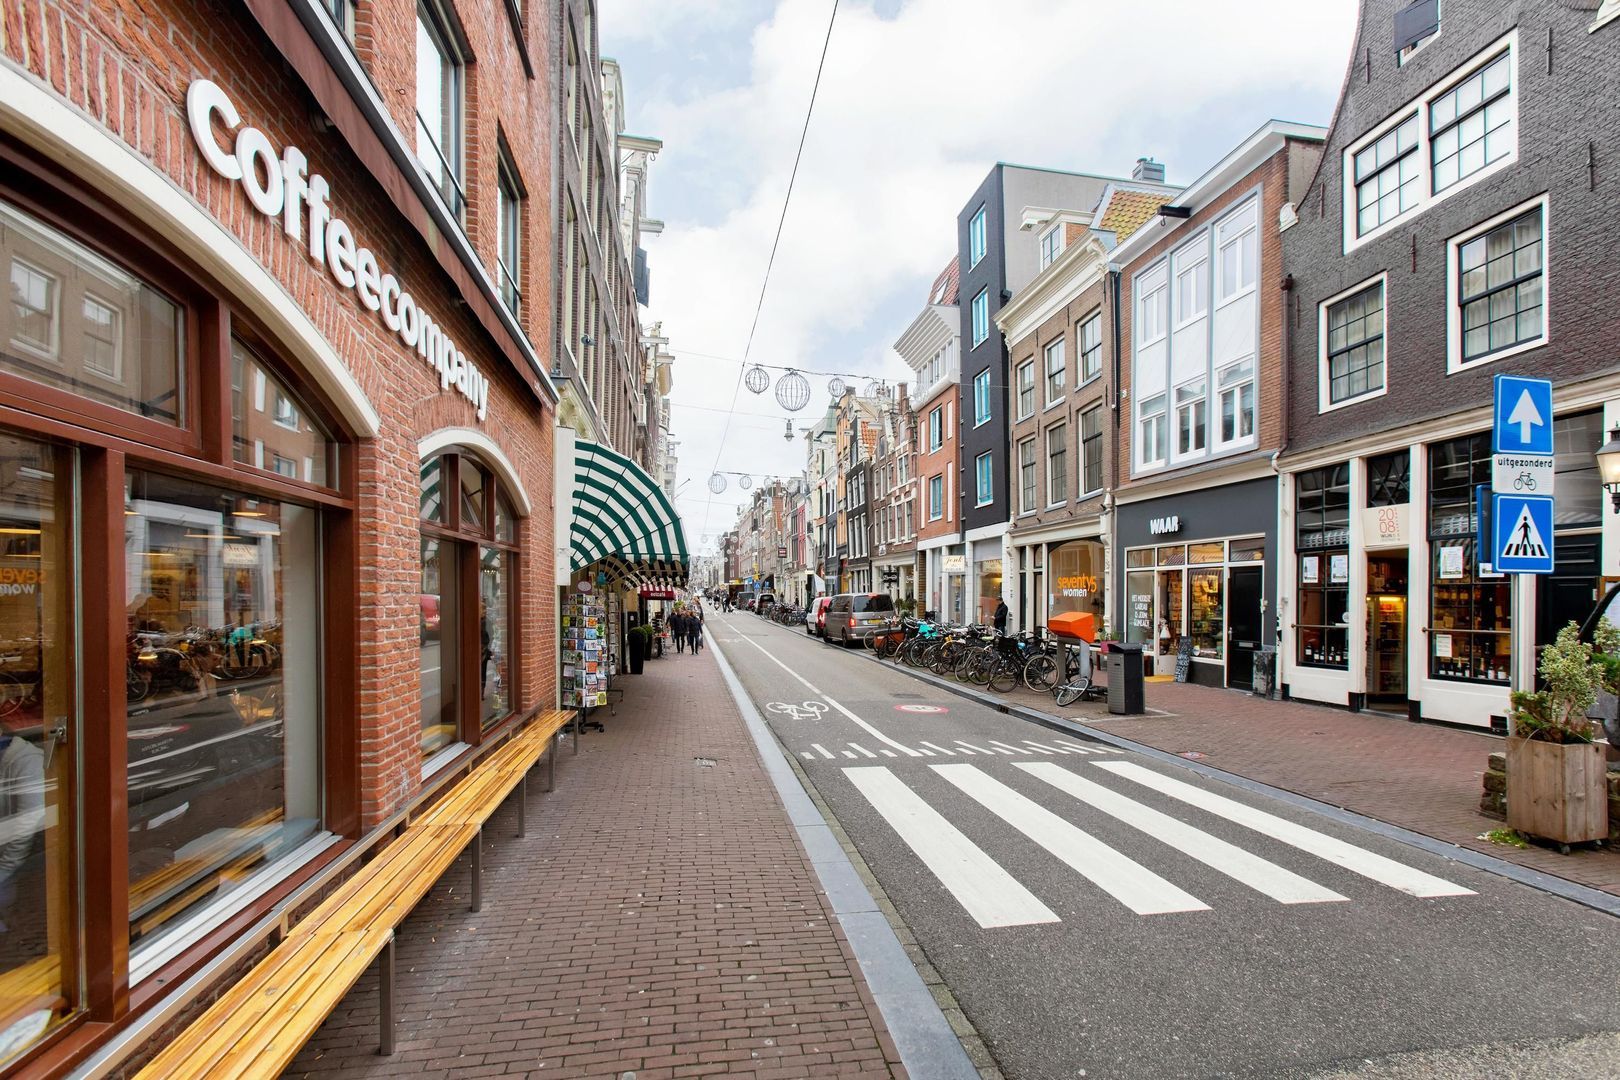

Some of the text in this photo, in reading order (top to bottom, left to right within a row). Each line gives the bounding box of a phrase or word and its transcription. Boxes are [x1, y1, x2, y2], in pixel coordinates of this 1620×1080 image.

[186, 78, 490, 422] coffeecompany
[1498, 457, 1553, 468] uitgezonderd
[1150, 516, 1179, 535] WAAR
[1057, 573, 1097, 593] seventy5
[1063, 588, 1087, 597] women
